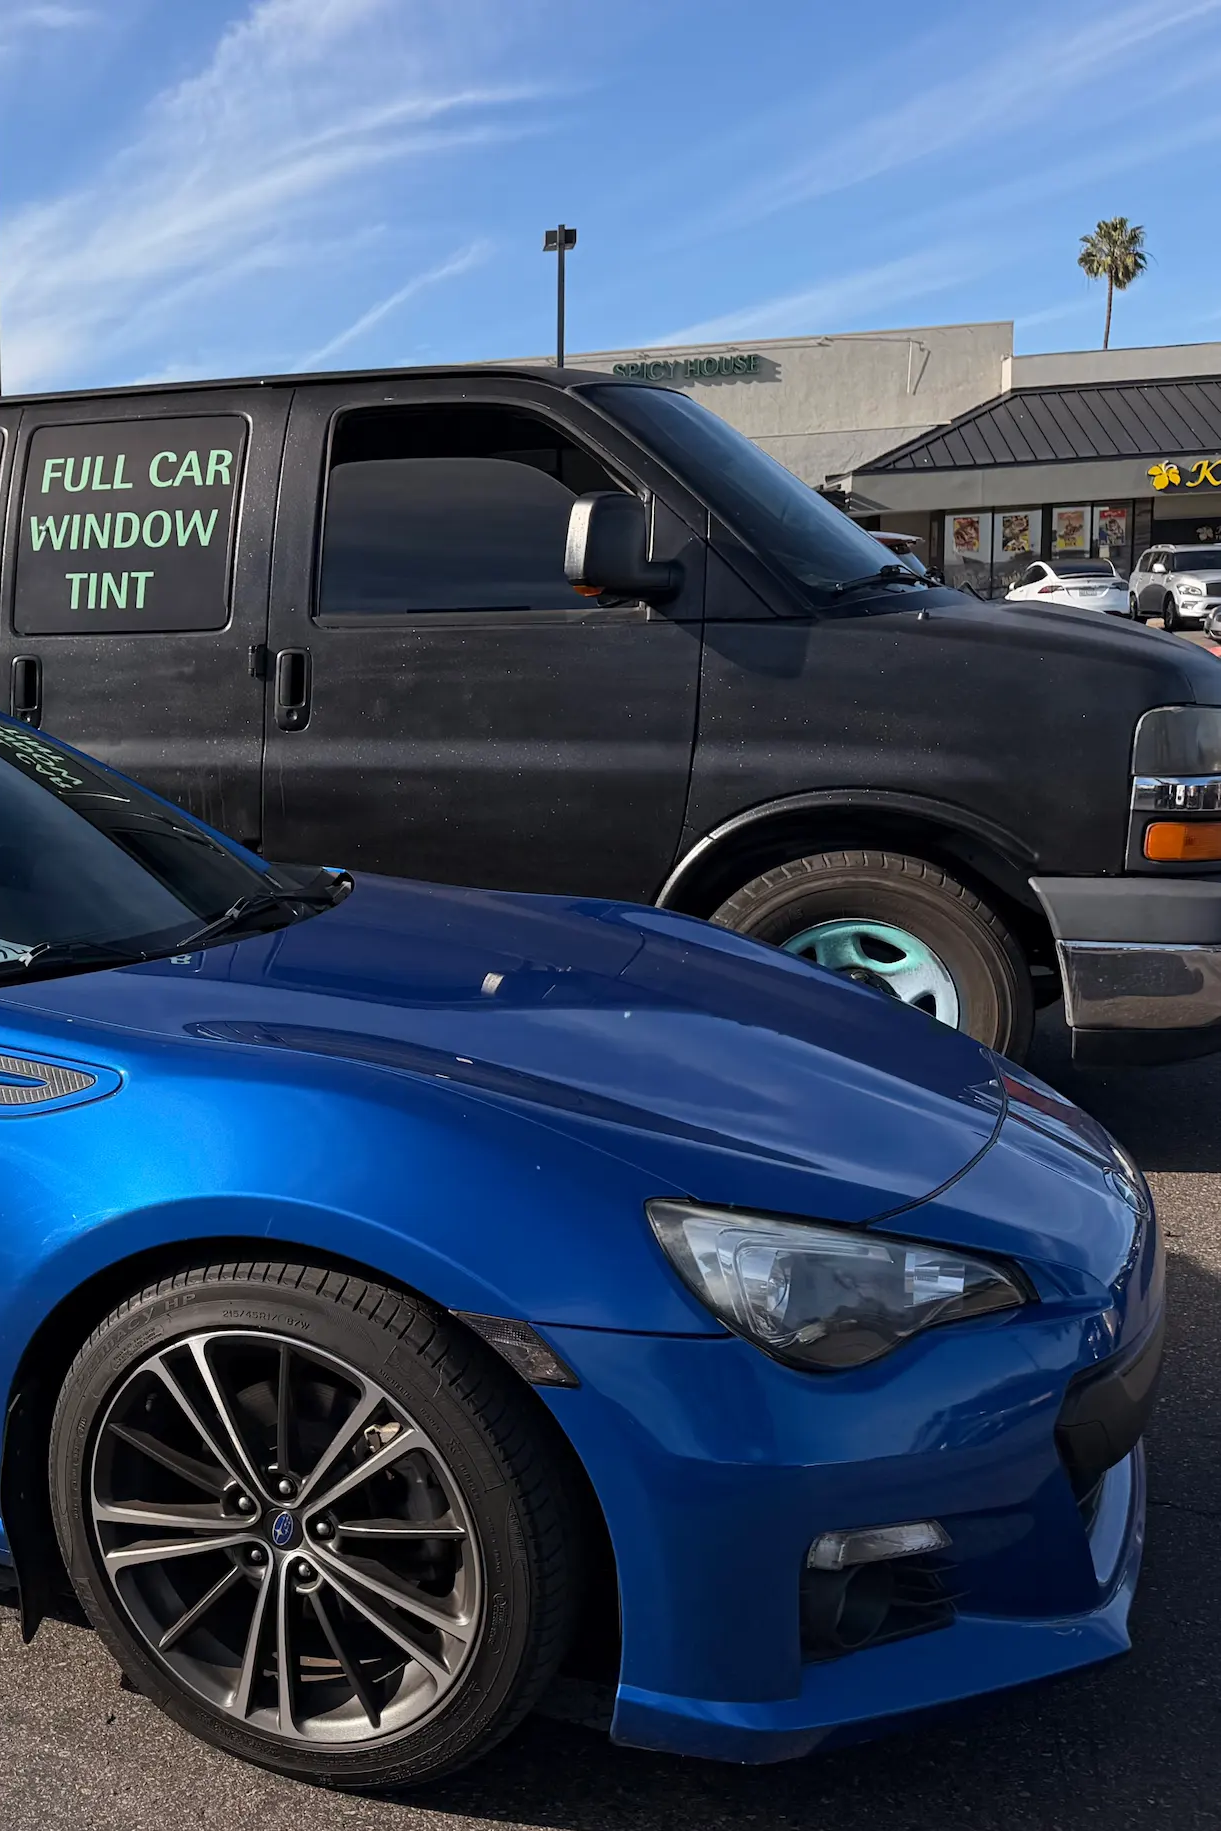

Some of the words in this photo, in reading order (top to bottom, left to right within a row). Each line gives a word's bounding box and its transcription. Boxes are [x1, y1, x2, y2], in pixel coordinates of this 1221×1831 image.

[612, 359, 677, 381] SPICY
[684, 354, 760, 378] HOUSE
[41, 455, 133, 494] FULL
[149, 449, 233, 488] CAR
[30, 509, 218, 552] WINDOW
[66, 571, 153, 610] TINT
[164, 1293, 196, 1312] HP
